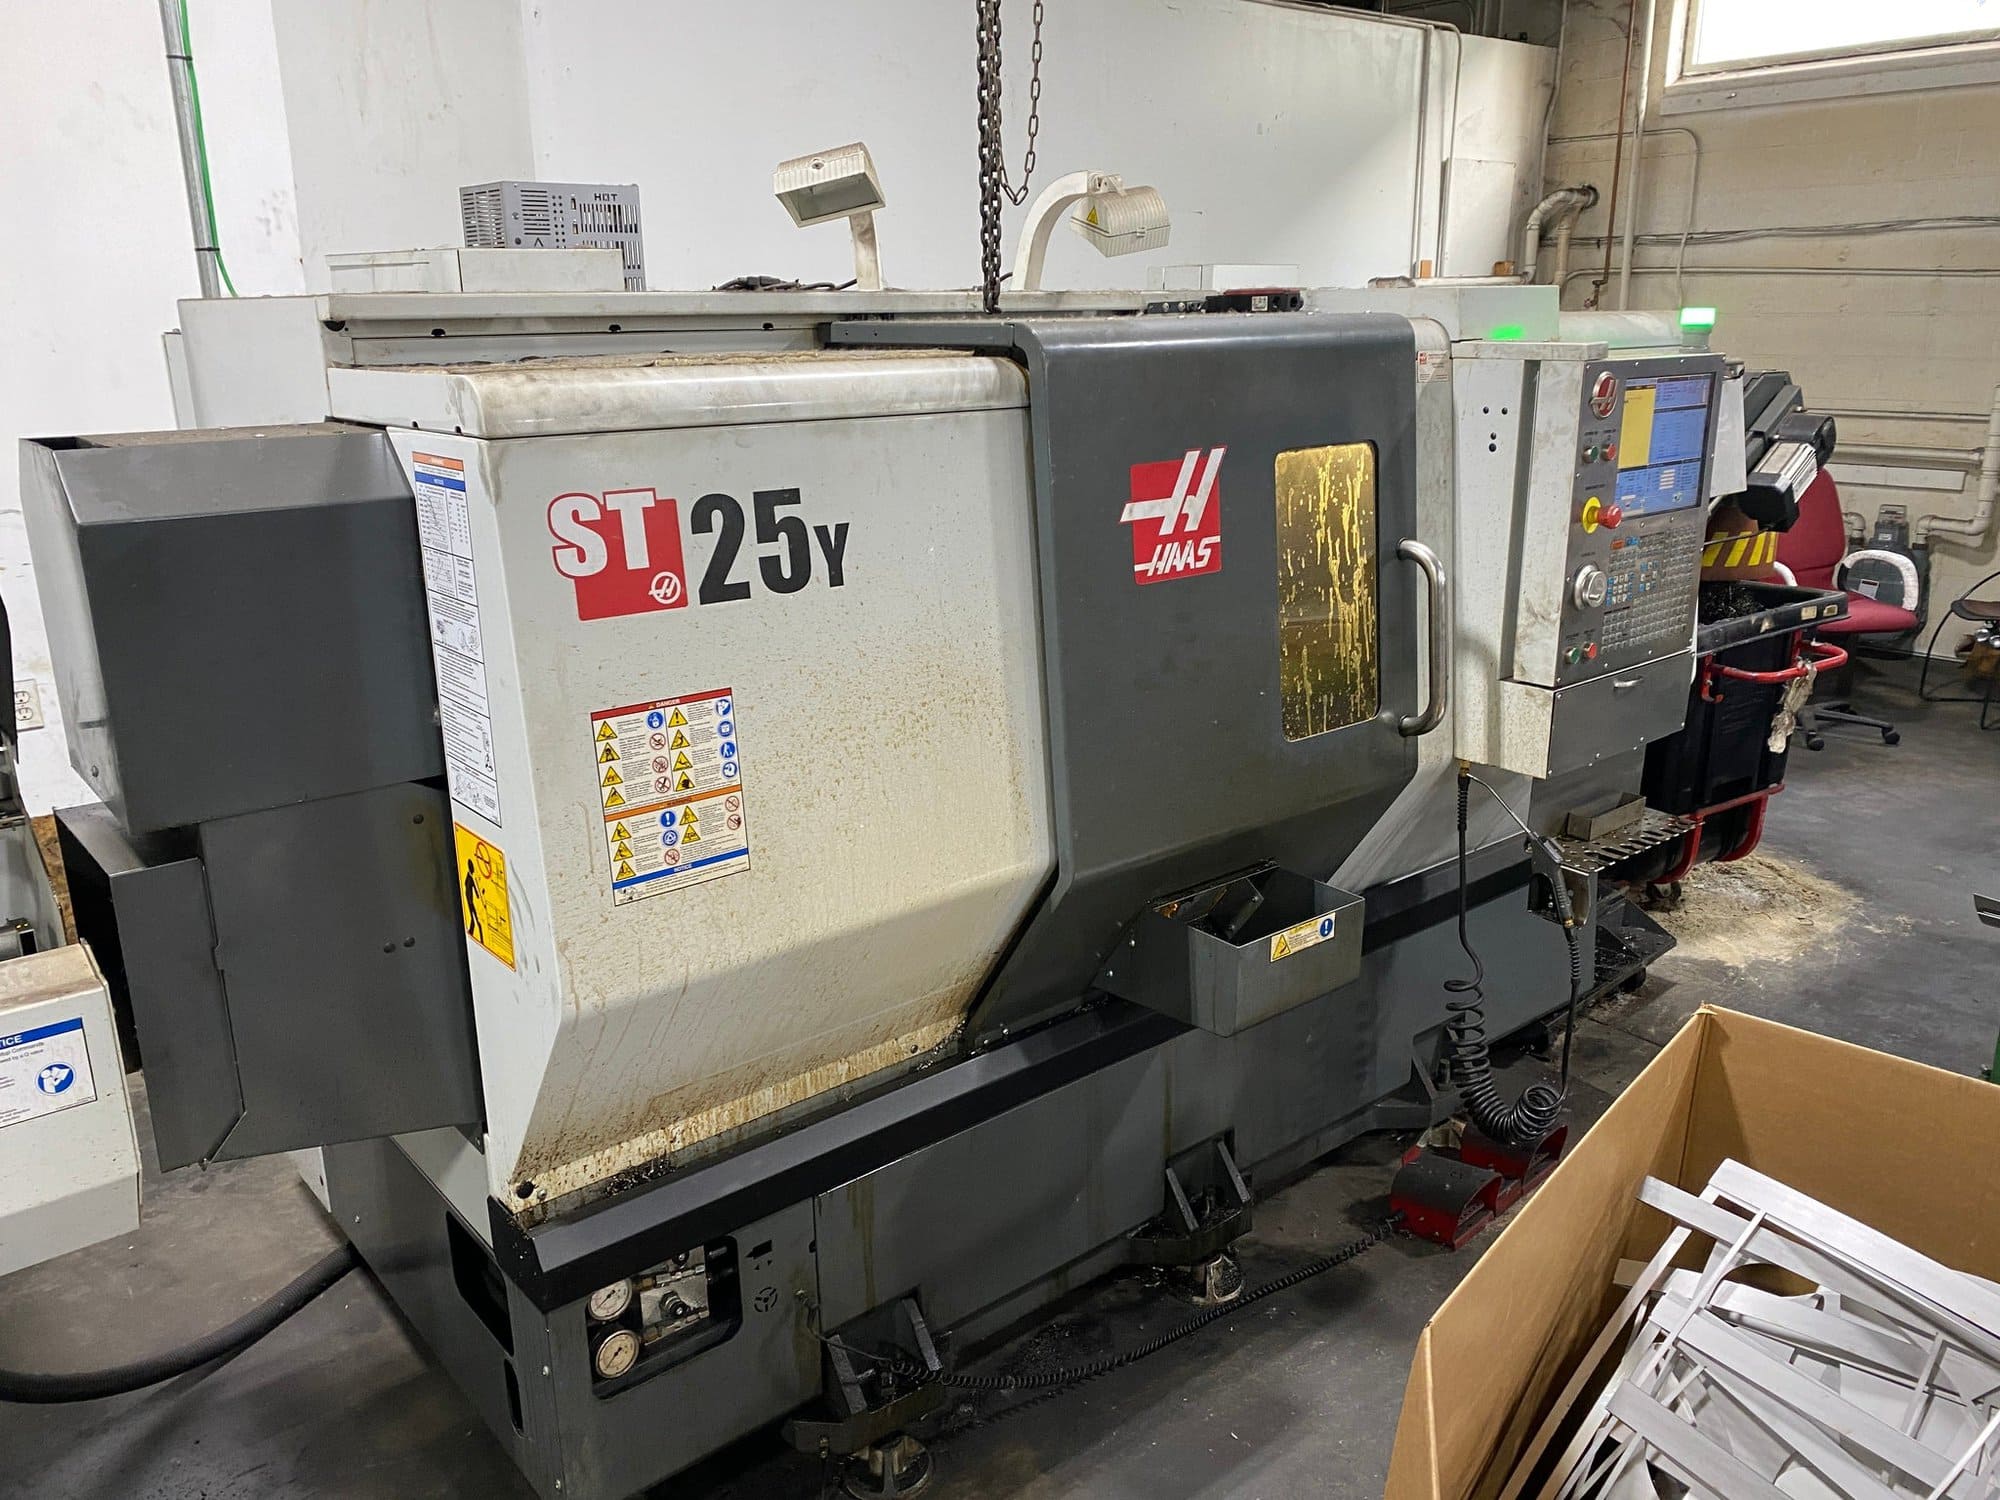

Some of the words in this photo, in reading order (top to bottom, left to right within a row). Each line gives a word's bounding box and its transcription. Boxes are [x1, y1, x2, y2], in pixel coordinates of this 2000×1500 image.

[594, 192, 619, 202] HOT
[548, 488, 657, 578] ST
[1134, 535, 1222, 577] HAAS
